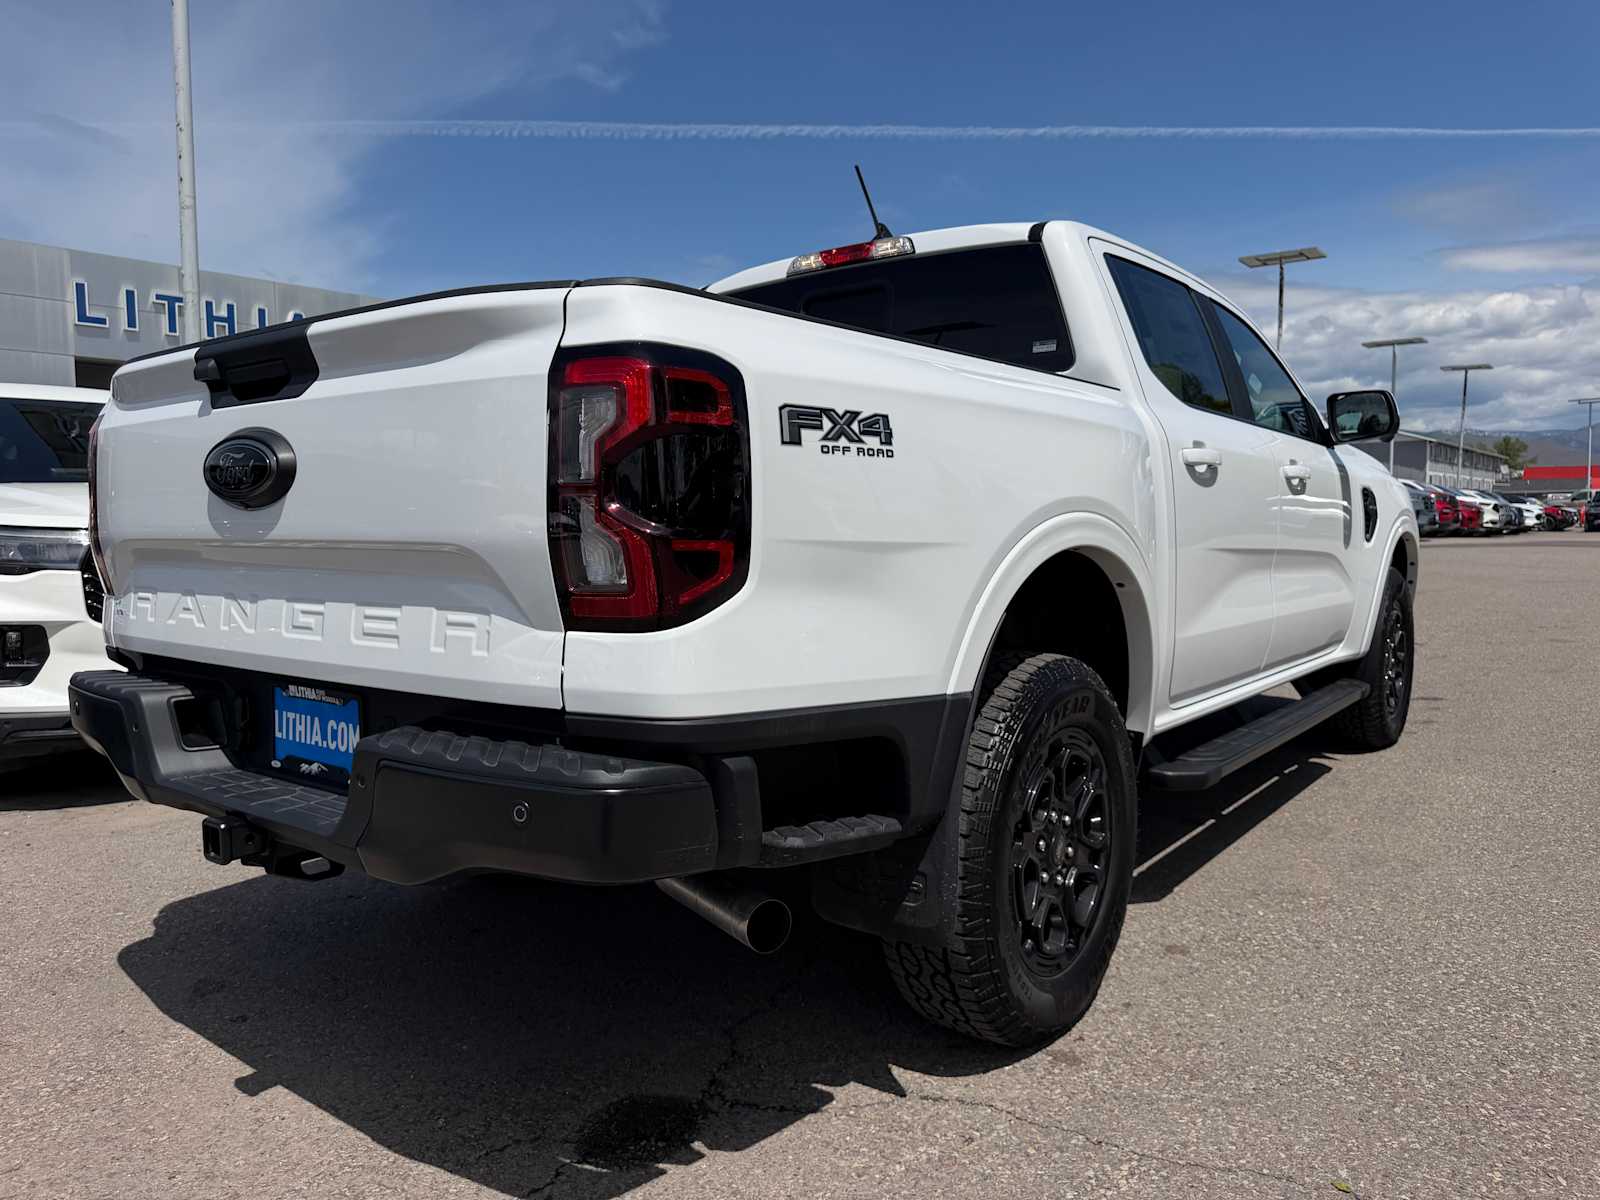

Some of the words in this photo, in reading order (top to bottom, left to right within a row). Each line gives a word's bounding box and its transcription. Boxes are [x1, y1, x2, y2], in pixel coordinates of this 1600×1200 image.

[72, 279, 305, 337] LITHI
[778, 403, 893, 446] FX4
[216, 453, 254, 485] Ford
[820, 445, 851, 455] OFF
[857, 447, 894, 458] ROAD
[129, 592, 489, 656] RANGER
[274, 709, 360, 753] LITHIA.COM
